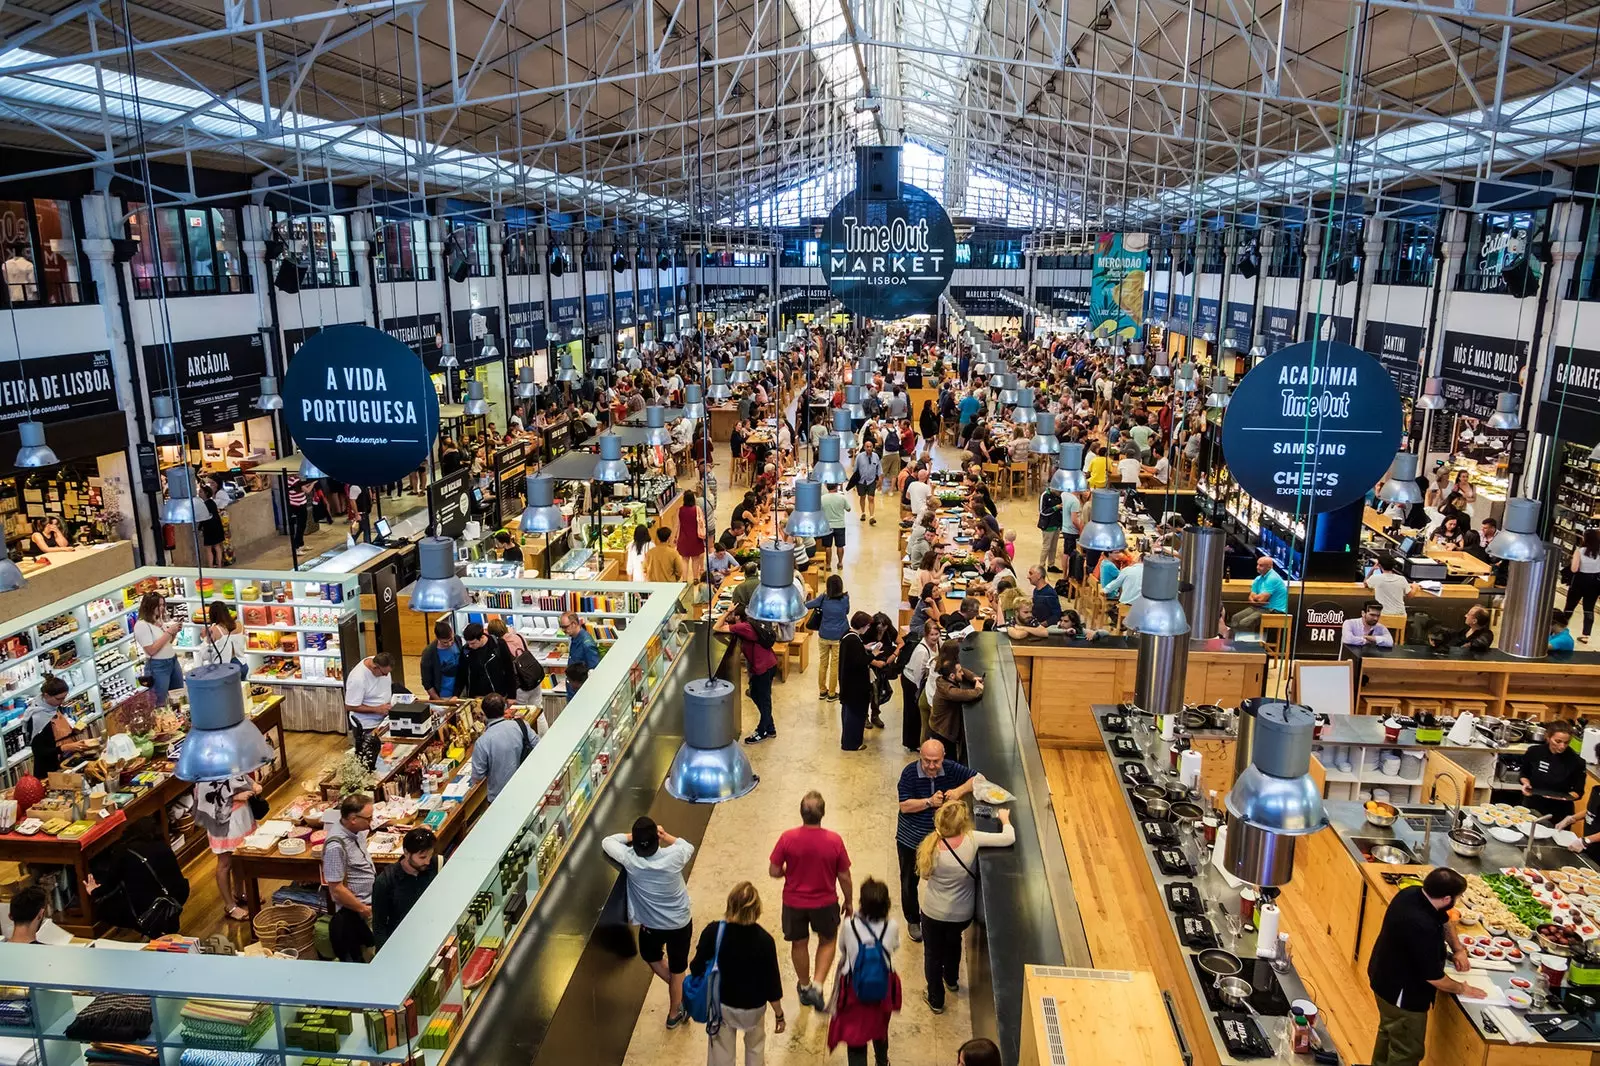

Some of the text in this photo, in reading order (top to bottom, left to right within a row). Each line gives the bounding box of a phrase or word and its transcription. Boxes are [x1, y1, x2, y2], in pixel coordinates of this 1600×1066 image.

[831, 257, 944, 272] MARKET
[867, 277, 907, 285] LISBOA
[188, 350, 230, 377] ARCÁDIA
[1453, 343, 1519, 374] NÓS É MAIS BOLOS
[326, 367, 387, 391] A VIDA
[0, 368, 111, 406] EIRA DE LISBOA
[302, 398, 417, 424] PORTUGUESA
[335, 434, 388, 445] Desde sempre
[1273, 471, 1339, 486] CHEF'S
[1276, 487, 1332, 497] EXPERIENCE
[1310, 628, 1335, 642] BAR
